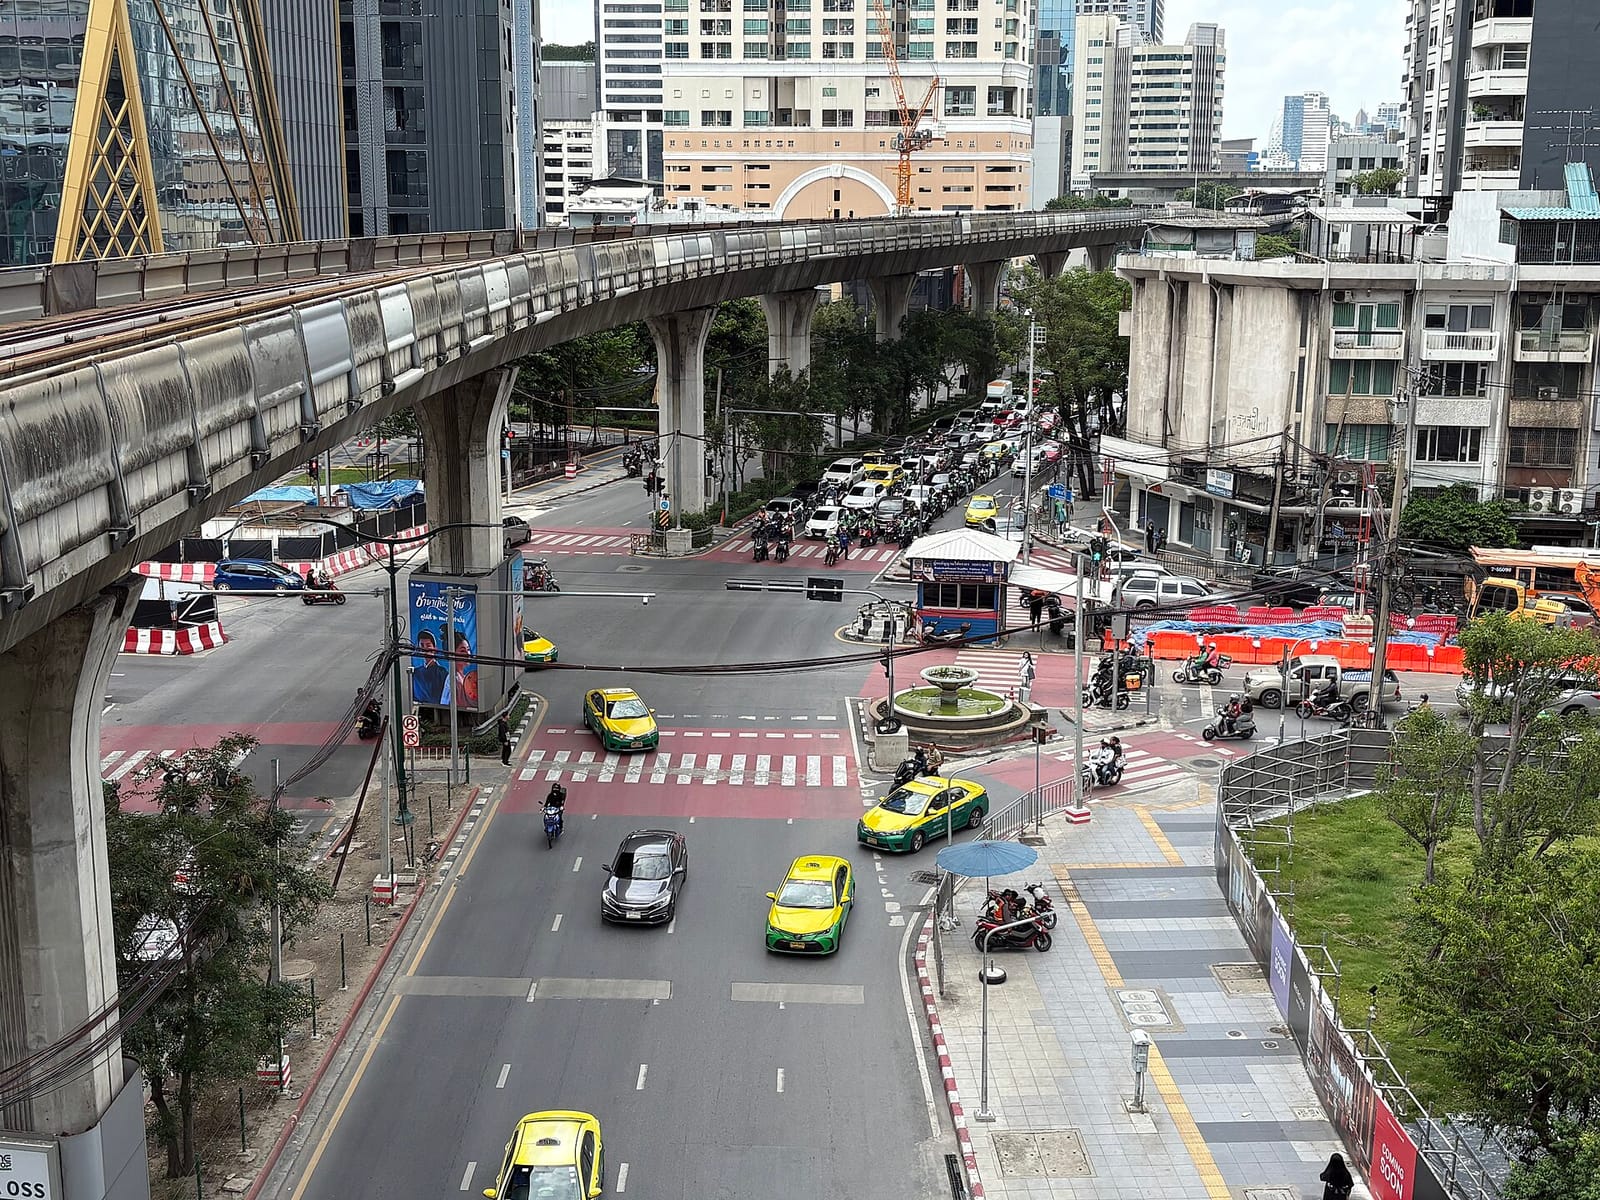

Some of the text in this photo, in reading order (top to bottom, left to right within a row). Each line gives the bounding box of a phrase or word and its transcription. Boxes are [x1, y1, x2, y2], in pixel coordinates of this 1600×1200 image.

[1380, 1156, 1404, 1200] SOON
[1381, 1143, 1405, 1180] COMING
[7, 1180, 46, 1199] OSS
